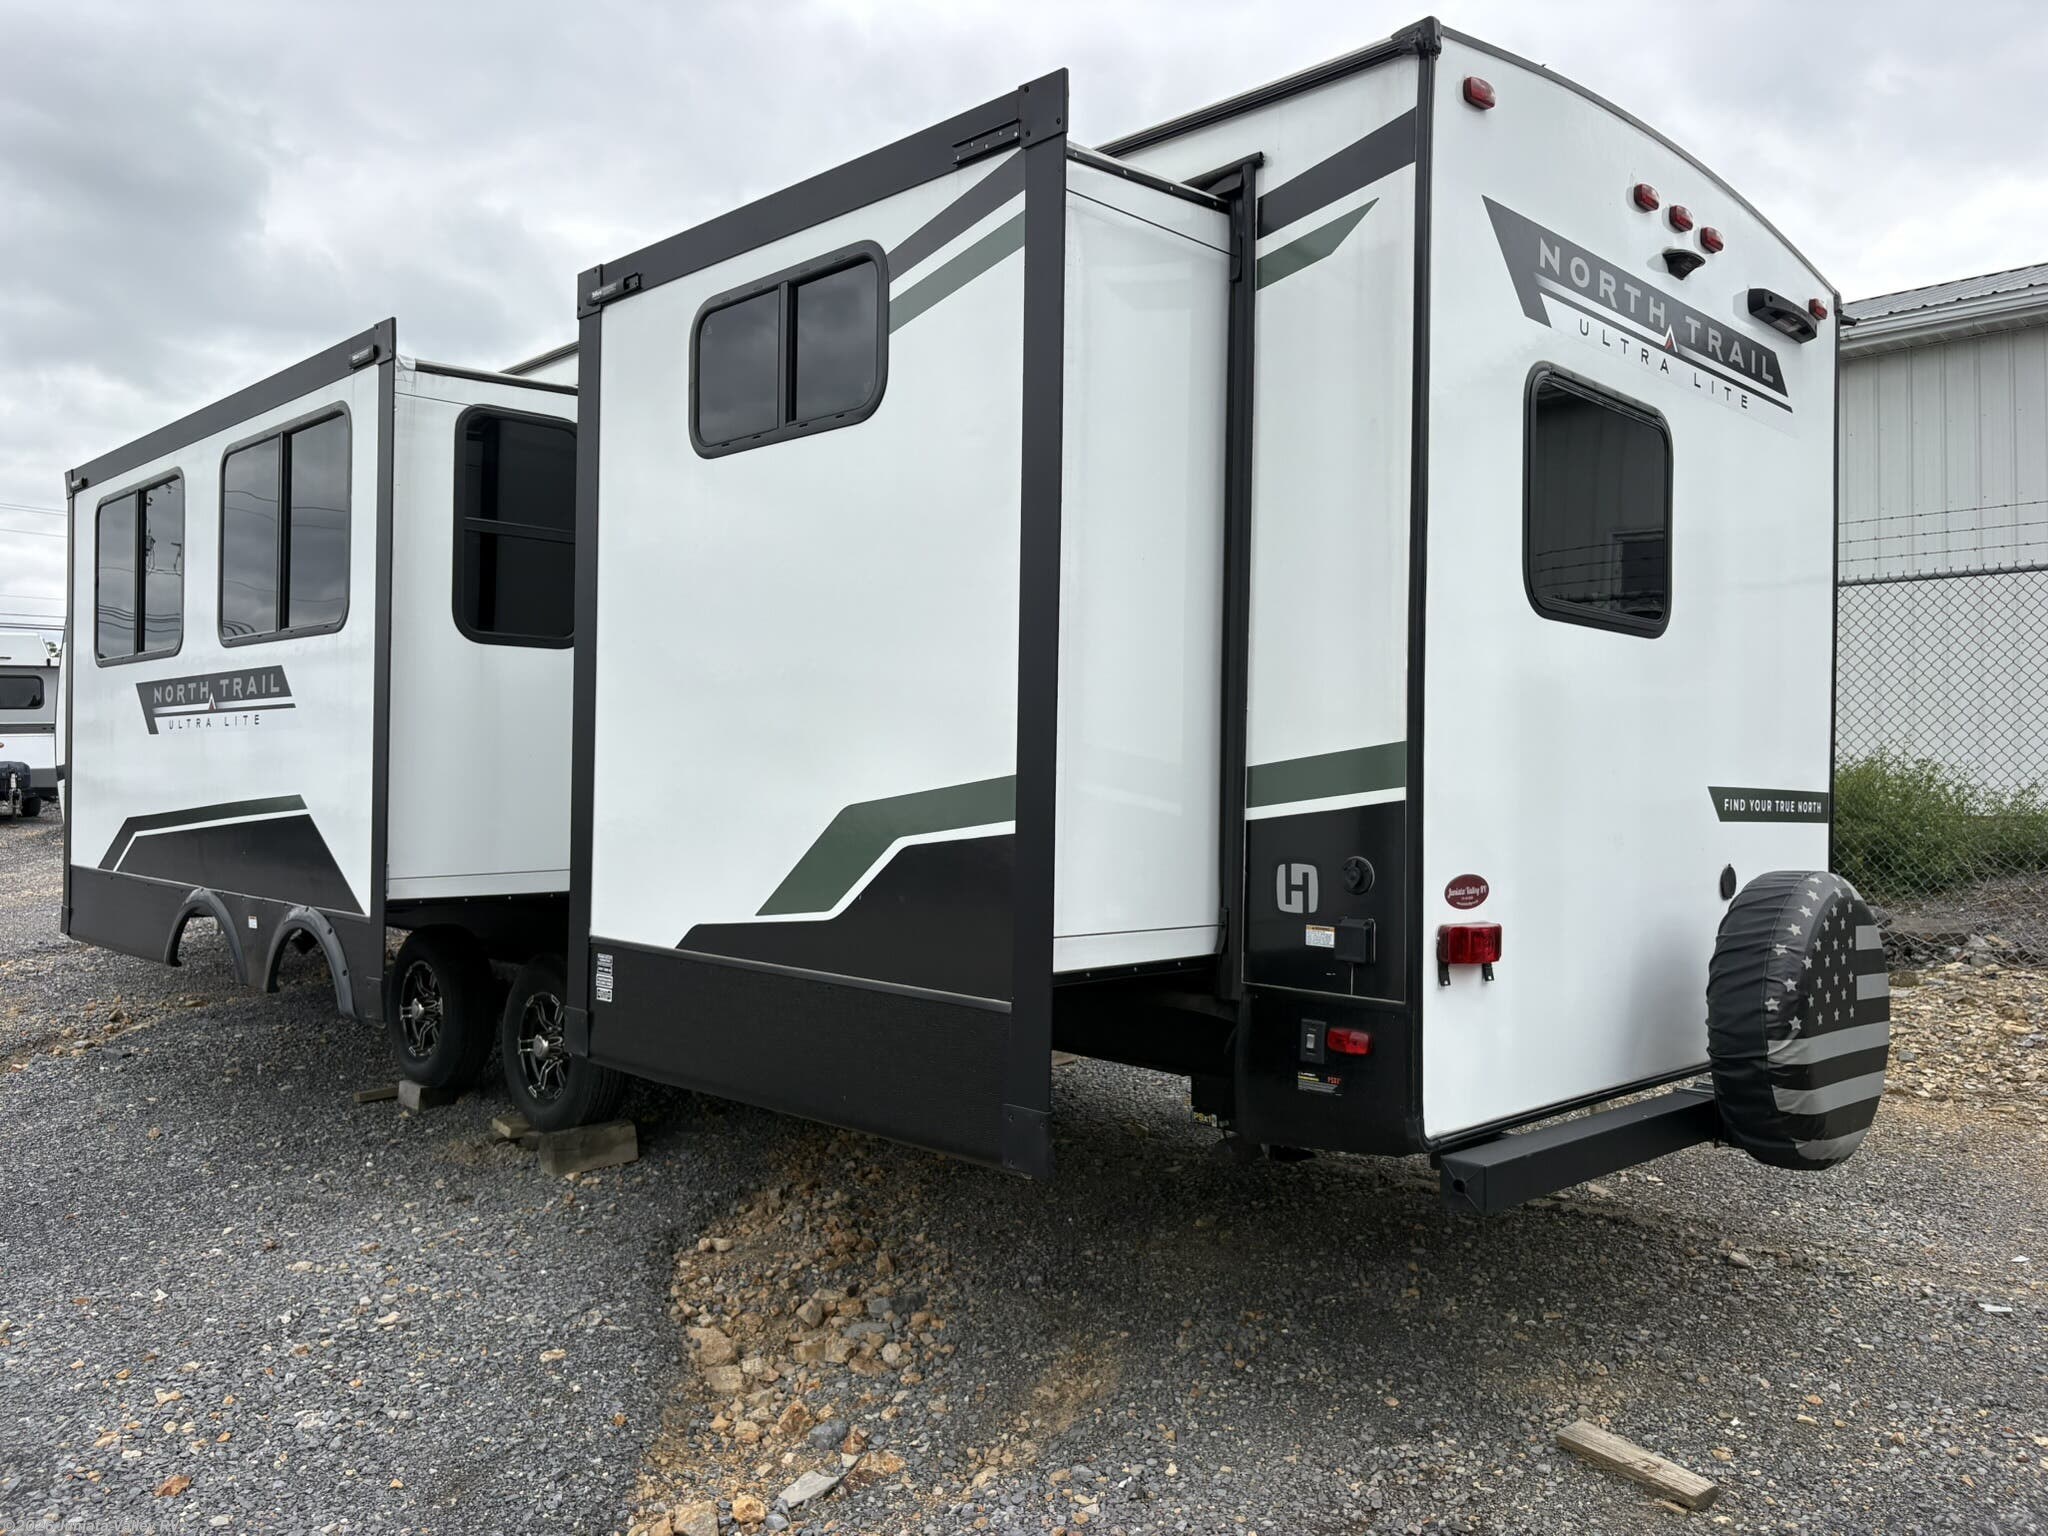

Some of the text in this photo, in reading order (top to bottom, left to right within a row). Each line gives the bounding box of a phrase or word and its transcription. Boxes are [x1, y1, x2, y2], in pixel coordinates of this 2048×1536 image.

[1539, 237, 1774, 384] NORTH TRAIL
[1579, 318, 1749, 410] ULTRA LITE
[154, 674, 279, 703] NORTH TRAIL
[168, 714, 260, 730] ULTRA LITE
[1724, 799, 1822, 814] FIND YOUR TRUE NORTH
